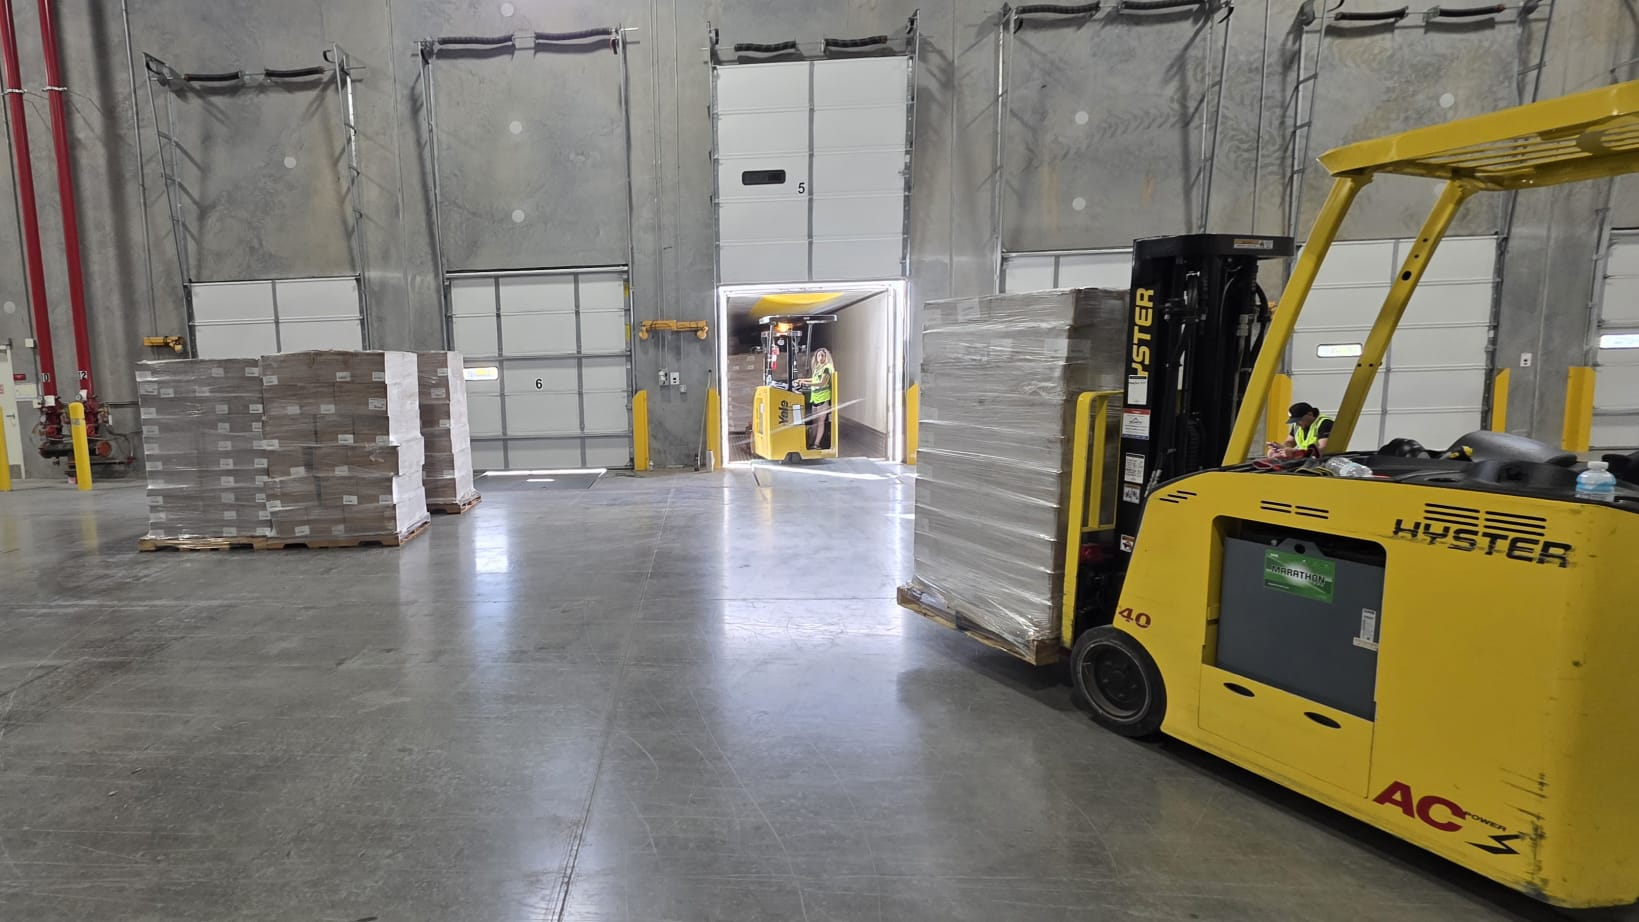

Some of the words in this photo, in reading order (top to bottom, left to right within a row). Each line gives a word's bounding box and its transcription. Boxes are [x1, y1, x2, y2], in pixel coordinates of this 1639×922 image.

[798, 182, 805, 194] 5
[1131, 287, 1154, 376] YSTER
[535, 378, 543, 389] 6
[778, 400, 789, 425] Yale
[1393, 519, 1573, 568] HYSTER
[1271, 565, 1326, 584] MARATHON
[1118, 607, 1152, 629] 40
[1372, 780, 1467, 832] AC
[1464, 810, 1507, 832] POWER
